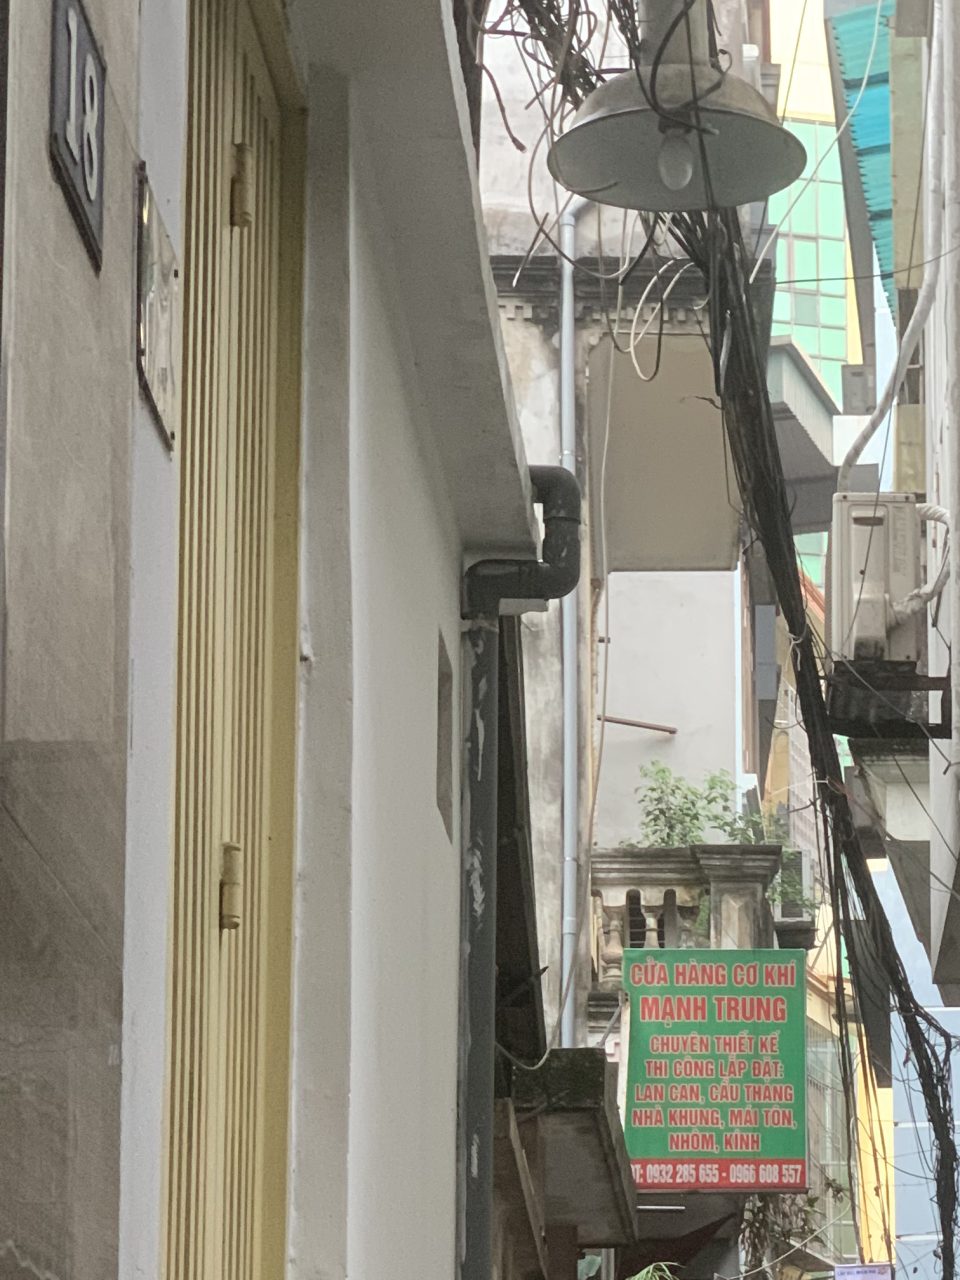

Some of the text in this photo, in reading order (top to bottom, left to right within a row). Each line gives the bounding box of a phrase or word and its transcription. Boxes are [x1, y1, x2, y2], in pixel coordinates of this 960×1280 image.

[65, 7, 98, 201] 18
[631, 956, 795, 986] CỬA HÀNG CƠ KHÍ
[640, 995, 786, 1026] MẠNH TRUNG
[650, 1030, 780, 1053] CHUYÊN THIẾT KẾ
[645, 1060, 668, 1078] THI
[673, 1056, 715, 1078] CÔNG
[719, 1053, 746, 1078] LẮP
[635, 1078, 793, 1104] LAN CAN, CẦU THANG
[632, 1105, 797, 1128] NHÀ KHUNG, MÁI TÔN,
[669, 1130, 760, 1153] NHÔM, KÍNH
[646, 1164, 673, 1183] 0932
[676, 1164, 697, 1183] 285
[699, 1164, 719, 1183] 655
[729, 1164, 756, 1184] 0966
[759, 1164, 779, 1184] 608
[782, 1164, 801, 1184] 557
